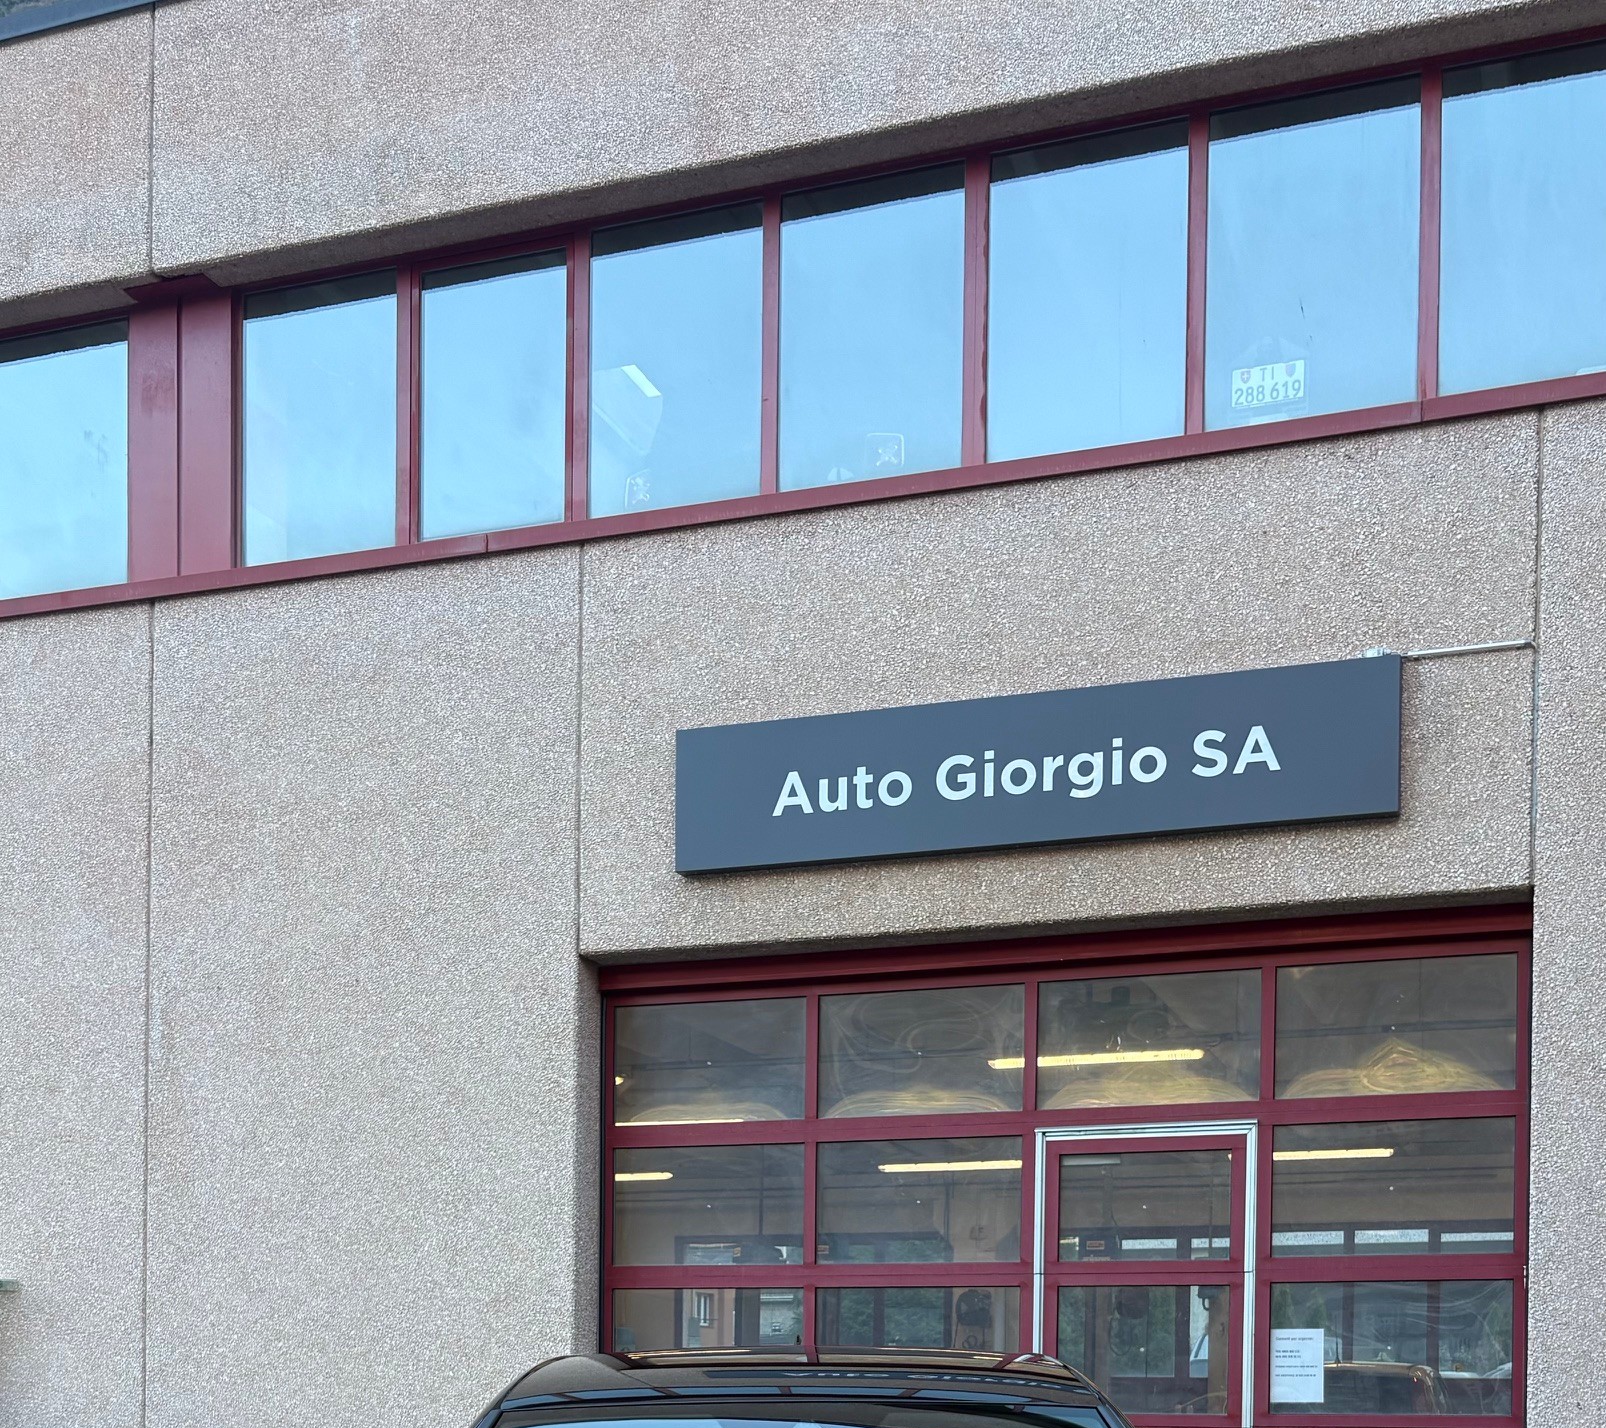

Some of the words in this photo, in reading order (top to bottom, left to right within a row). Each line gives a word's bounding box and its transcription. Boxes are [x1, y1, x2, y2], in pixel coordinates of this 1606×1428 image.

[1260, 366, 1275, 382] TI
[1235, 385, 1265, 405] 288
[1270, 379, 1301, 400] 619
[772, 766, 914, 817] Auto
[935, 736, 1168, 800] Giorgio
[1191, 725, 1282, 778] SA
